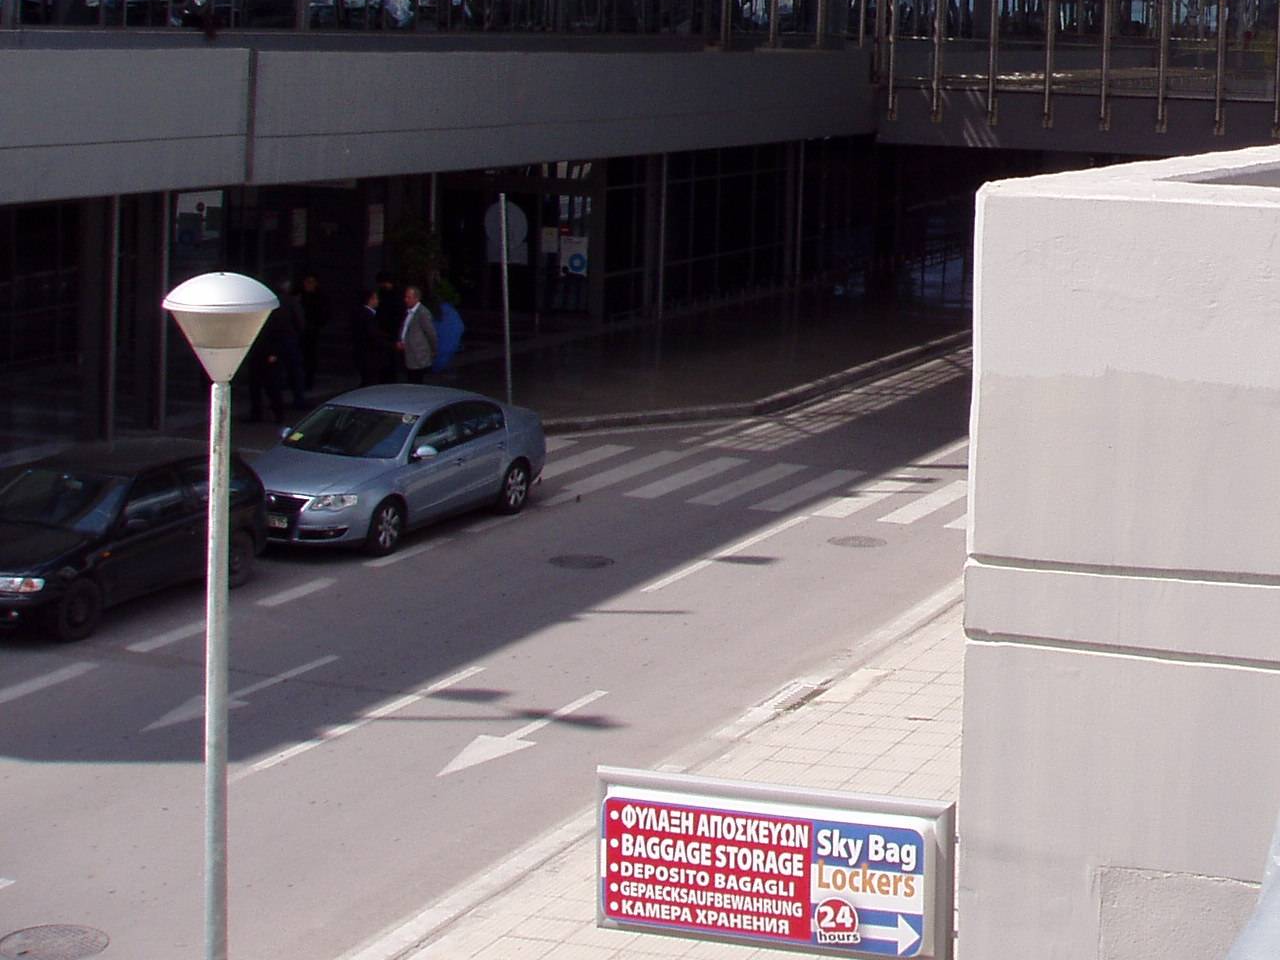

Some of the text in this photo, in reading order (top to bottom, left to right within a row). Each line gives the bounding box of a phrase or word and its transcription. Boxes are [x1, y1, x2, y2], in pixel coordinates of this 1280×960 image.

[621, 804, 809, 848] ΦΥΛΑΞΗ ΑΠΟΣΚΕΥΩΝ
[621, 833, 804, 877] BAGGAGE STORAGE
[817, 829, 917, 872] Sky Bag
[620, 861, 795, 897] DEPOSITO BAGAGLI
[817, 859, 915, 898] Lockers
[620, 881, 803, 917] GEPAECKSAUFBEWAHRUNG
[621, 899, 790, 935] КАМЕРА ХРАНЕНИЯ
[819, 906, 853, 929] 24
[818, 930, 859, 943] hours
